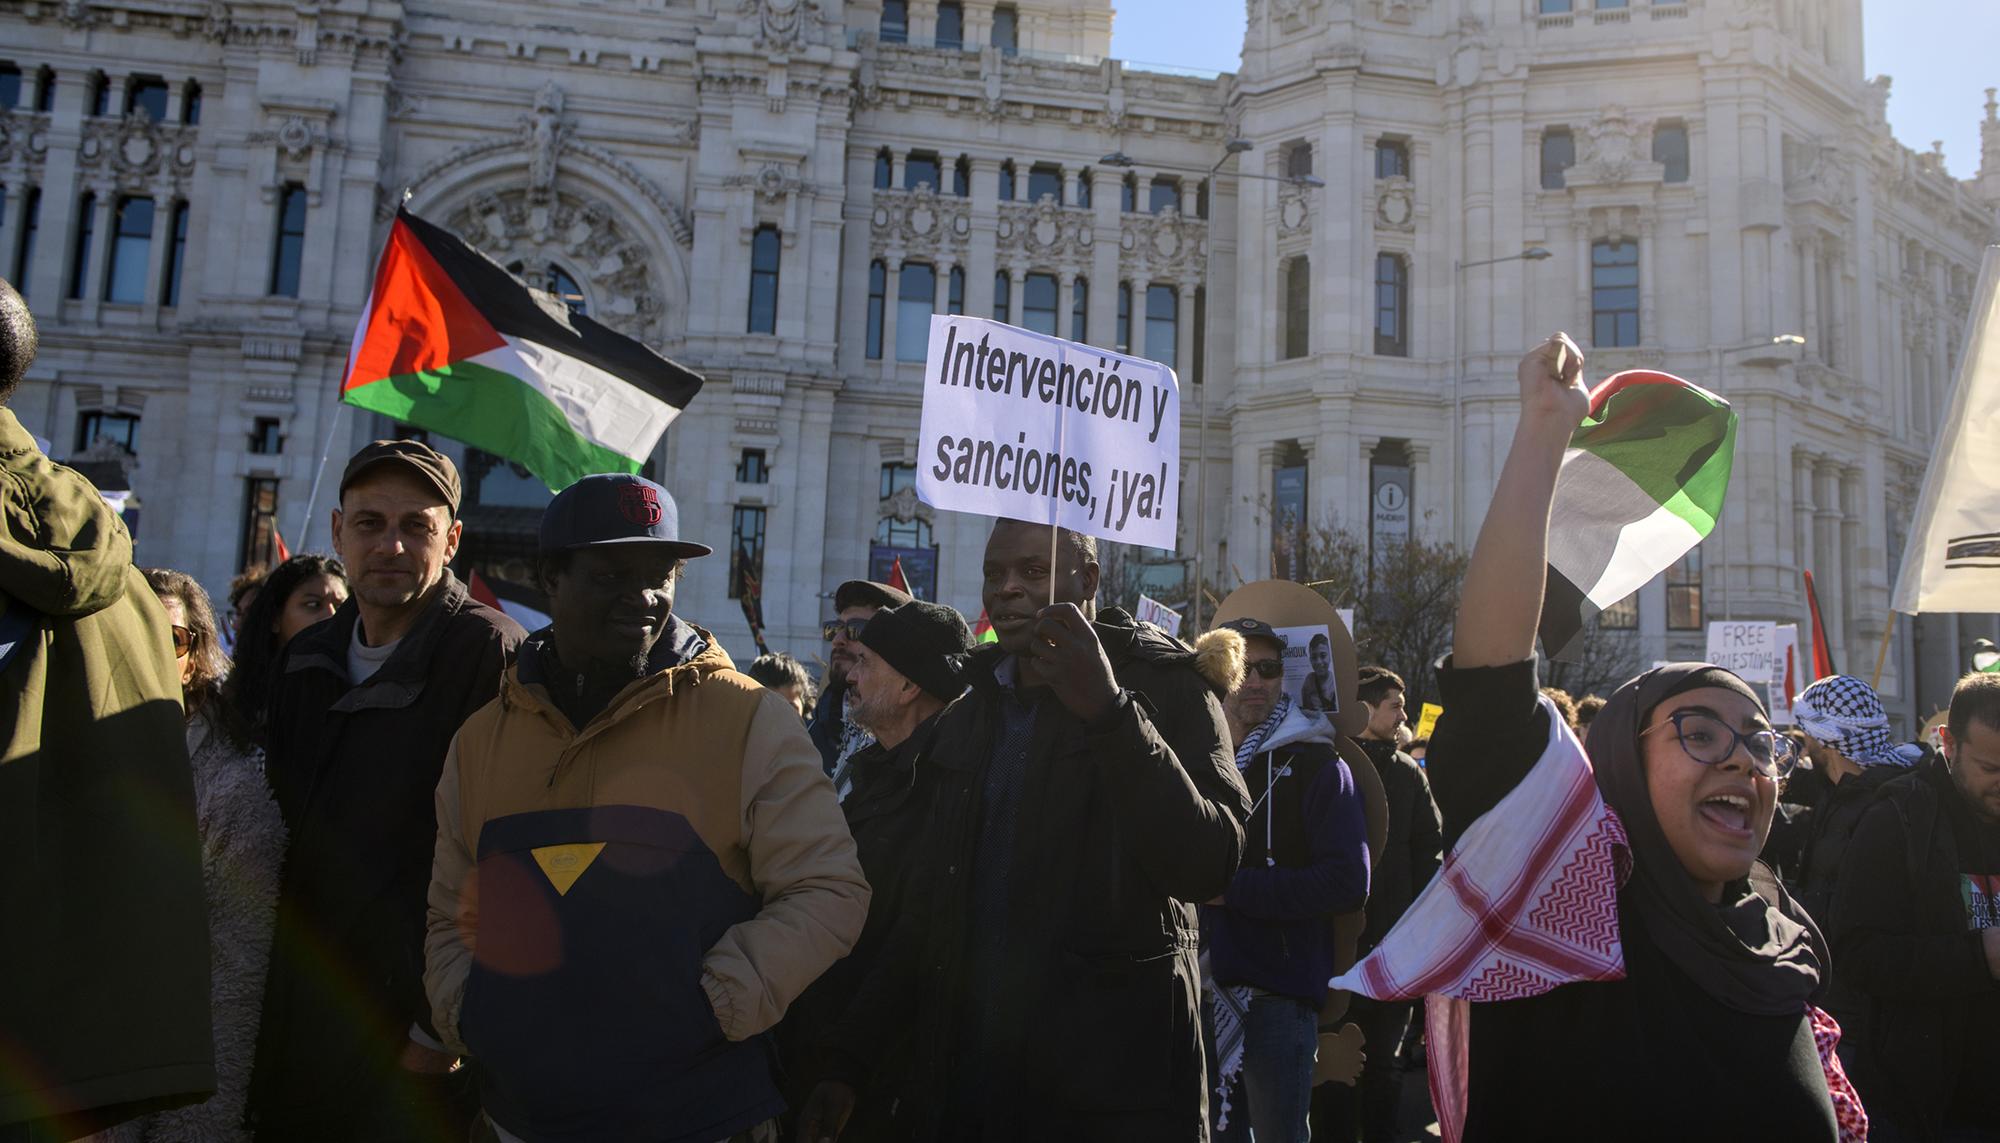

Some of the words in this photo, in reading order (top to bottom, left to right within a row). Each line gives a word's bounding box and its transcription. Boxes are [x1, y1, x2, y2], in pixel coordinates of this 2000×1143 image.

[940, 326, 1142, 423] Intervención
[1149, 385, 1168, 443] y
[933, 432, 1097, 521] sanciones,
[1103, 462, 1168, 532] ¡ya!
[1723, 625, 1766, 647] FREE
[1967, 891, 2000, 905] TODS
